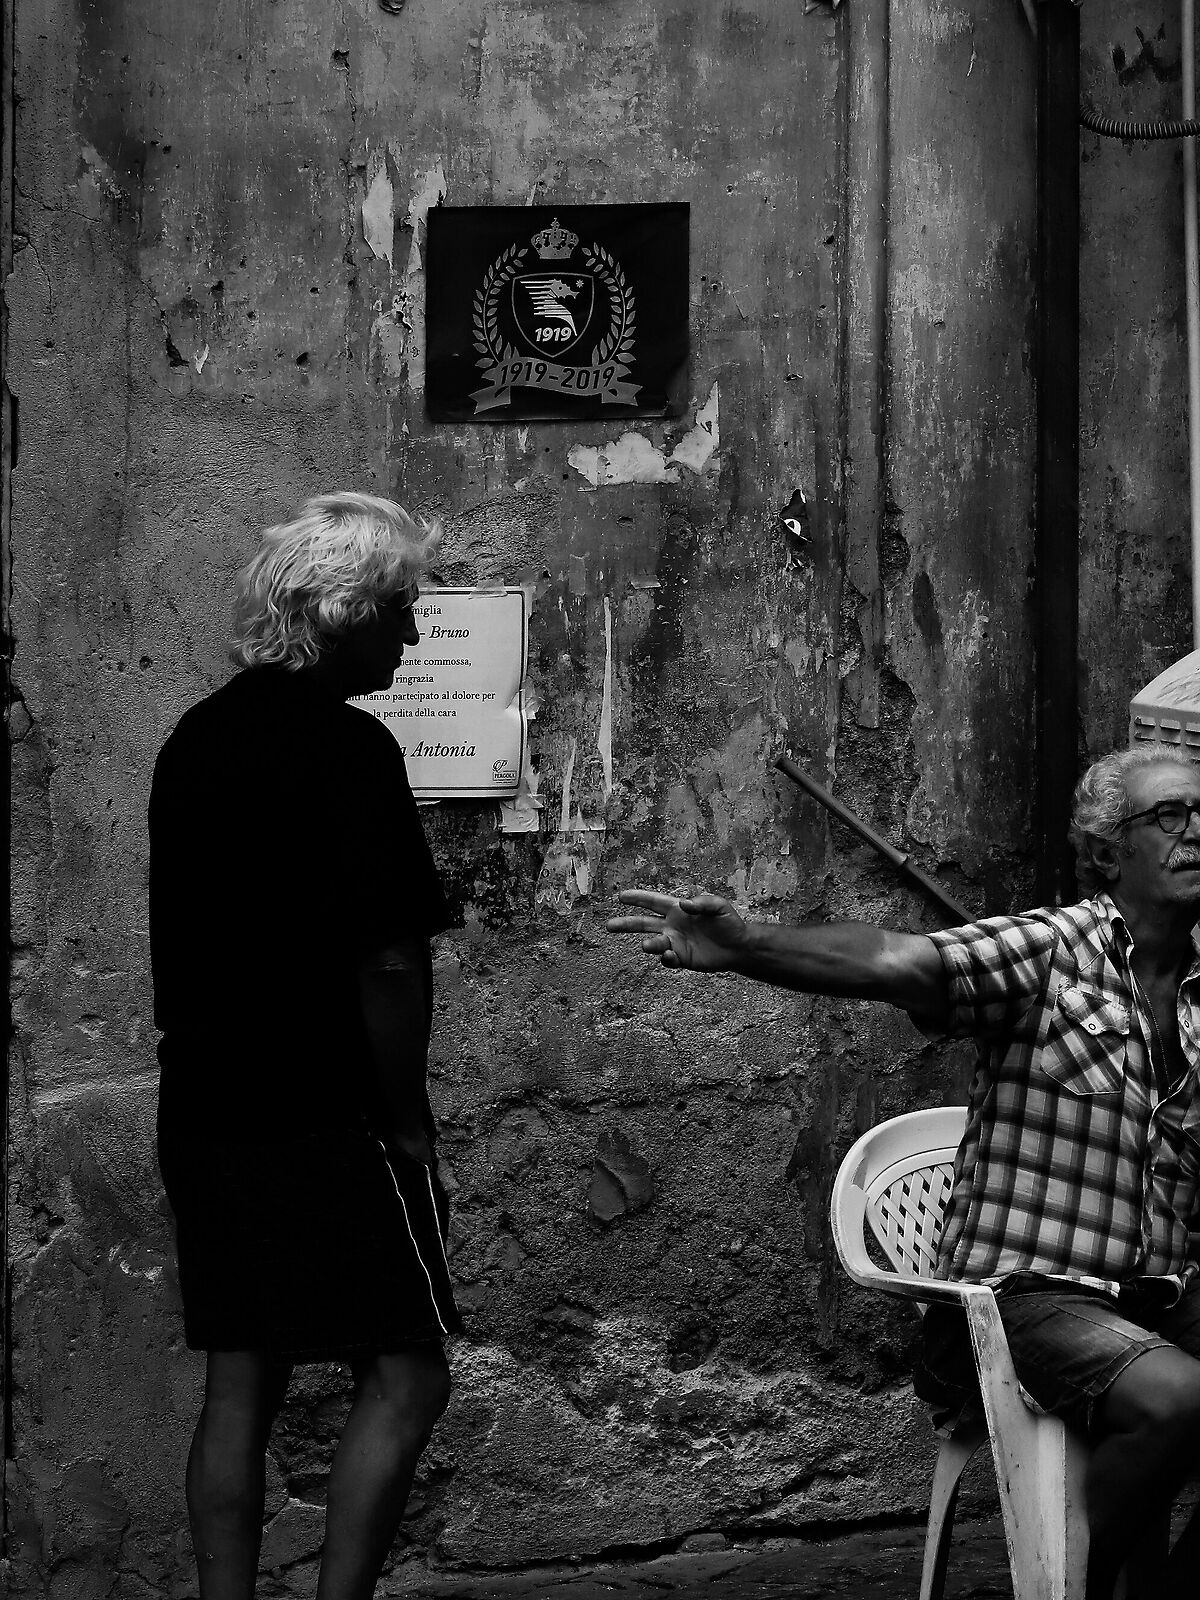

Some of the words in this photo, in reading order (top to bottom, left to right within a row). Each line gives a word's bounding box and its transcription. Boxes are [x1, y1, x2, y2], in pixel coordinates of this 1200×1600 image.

[535, 327, 572, 342] 1919
[500, 362, 615, 389] 1919-2019
[413, 604, 442, 618] miglia
[428, 625, 470, 639] Bruno
[423, 658, 473, 667] commossa,
[395, 673, 434, 686] ringrazia
[392, 690, 439, 703] partecipato
[442, 690, 450, 700] al
[452, 690, 480, 700] dolore
[482, 692, 496, 704] per
[383, 708, 413, 720] perdita
[414, 707, 436, 718] della
[437, 709, 457, 718] cara
[410, 740, 477, 758] Antonia
